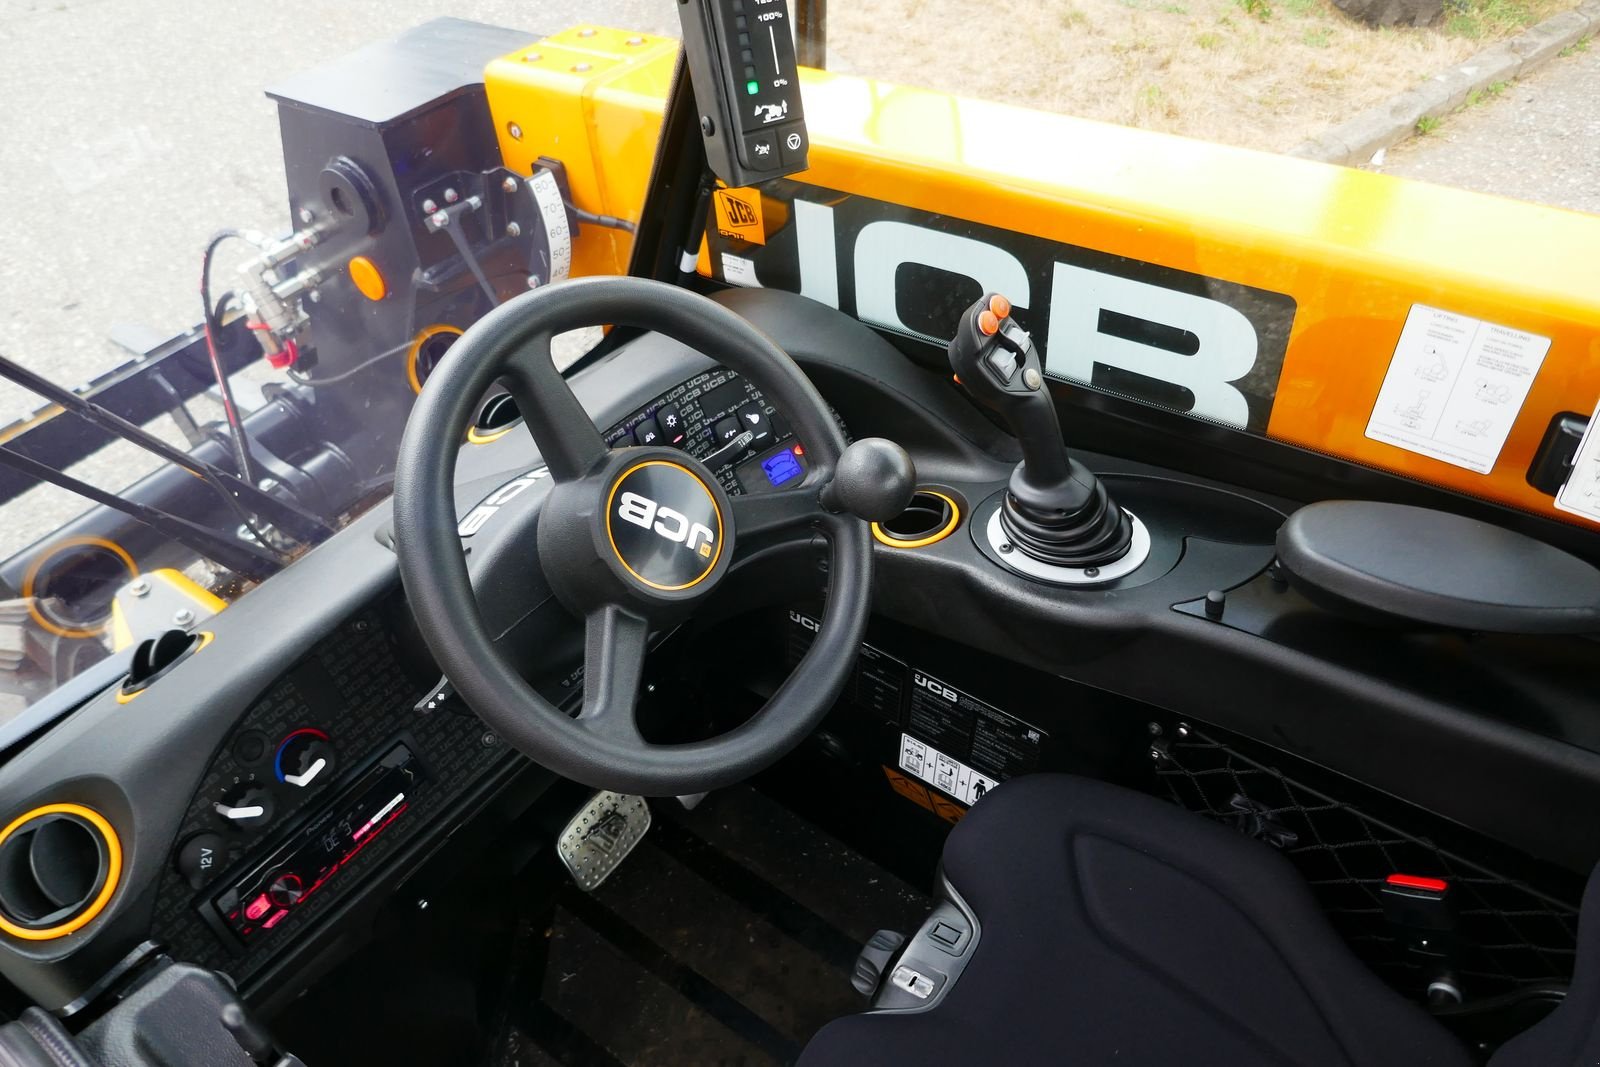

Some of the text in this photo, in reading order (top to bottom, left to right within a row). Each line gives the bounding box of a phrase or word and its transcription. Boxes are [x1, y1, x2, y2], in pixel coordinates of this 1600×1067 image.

[757, 11, 783, 22] 100%
[773, 79, 788, 88] 0%
[534, 180, 548, 193] 80
[543, 203, 557, 216] 70
[726, 197, 756, 224] JCB
[550, 226, 562, 238] 60
[552, 247, 565, 260] 50
[552, 266, 564, 278] 40
[666, 385, 686, 402] JCB
[686, 373, 710, 389] JCB
[680, 376, 726, 405] JCB JCB
[618, 491, 714, 550] JCB
[914, 673, 958, 703] JCB
[232, 776, 240, 784] 2
[248, 773, 255, 781] 3
[200, 847, 213, 870] 12V
